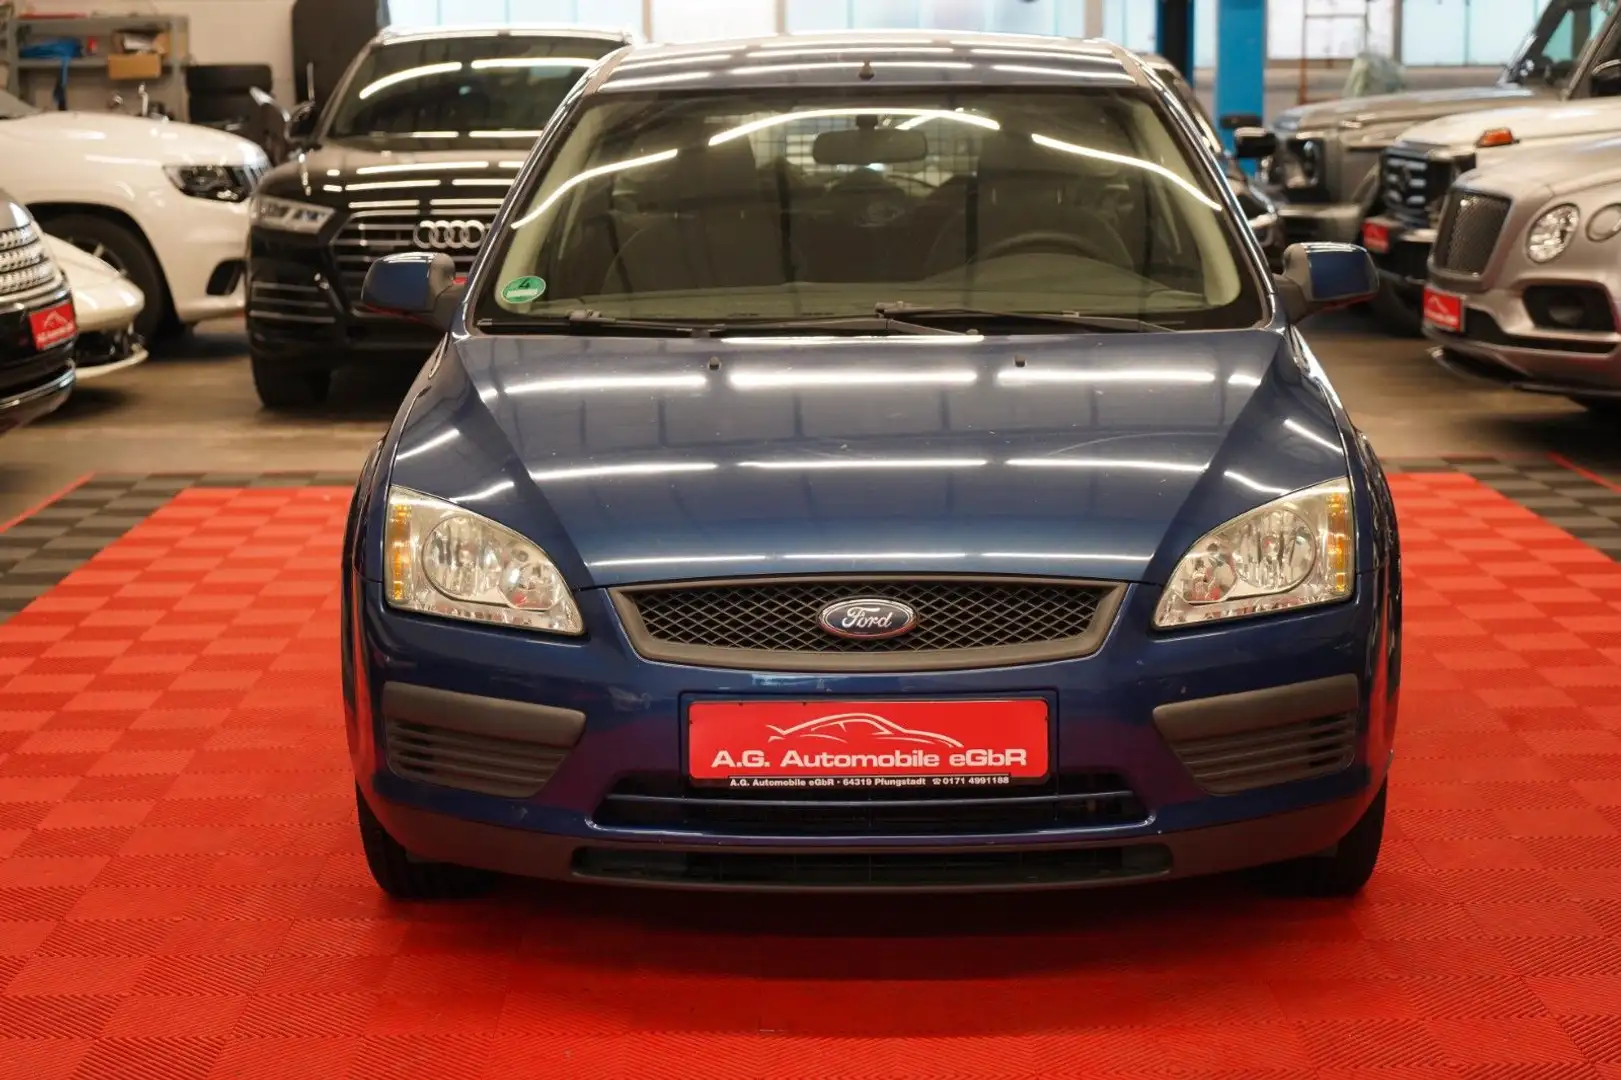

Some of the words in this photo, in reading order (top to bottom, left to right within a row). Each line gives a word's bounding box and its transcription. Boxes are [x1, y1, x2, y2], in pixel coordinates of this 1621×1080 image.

[518, 278, 530, 289] 4
[842, 606, 893, 628] Ford
[711, 750, 771, 768] A.G.
[780, 749, 940, 768] Automobile
[949, 748, 1027, 766] eGbR
[730, 778, 750, 787] A.G.
[752, 778, 806, 787] Automobile
[808, 777, 835, 786] eGbR
[843, 777, 872, 786] 64319
[874, 777, 926, 787] Pfungstadt
[942, 776, 965, 785] 0171
[968, 776, 1010, 785] 4991188
